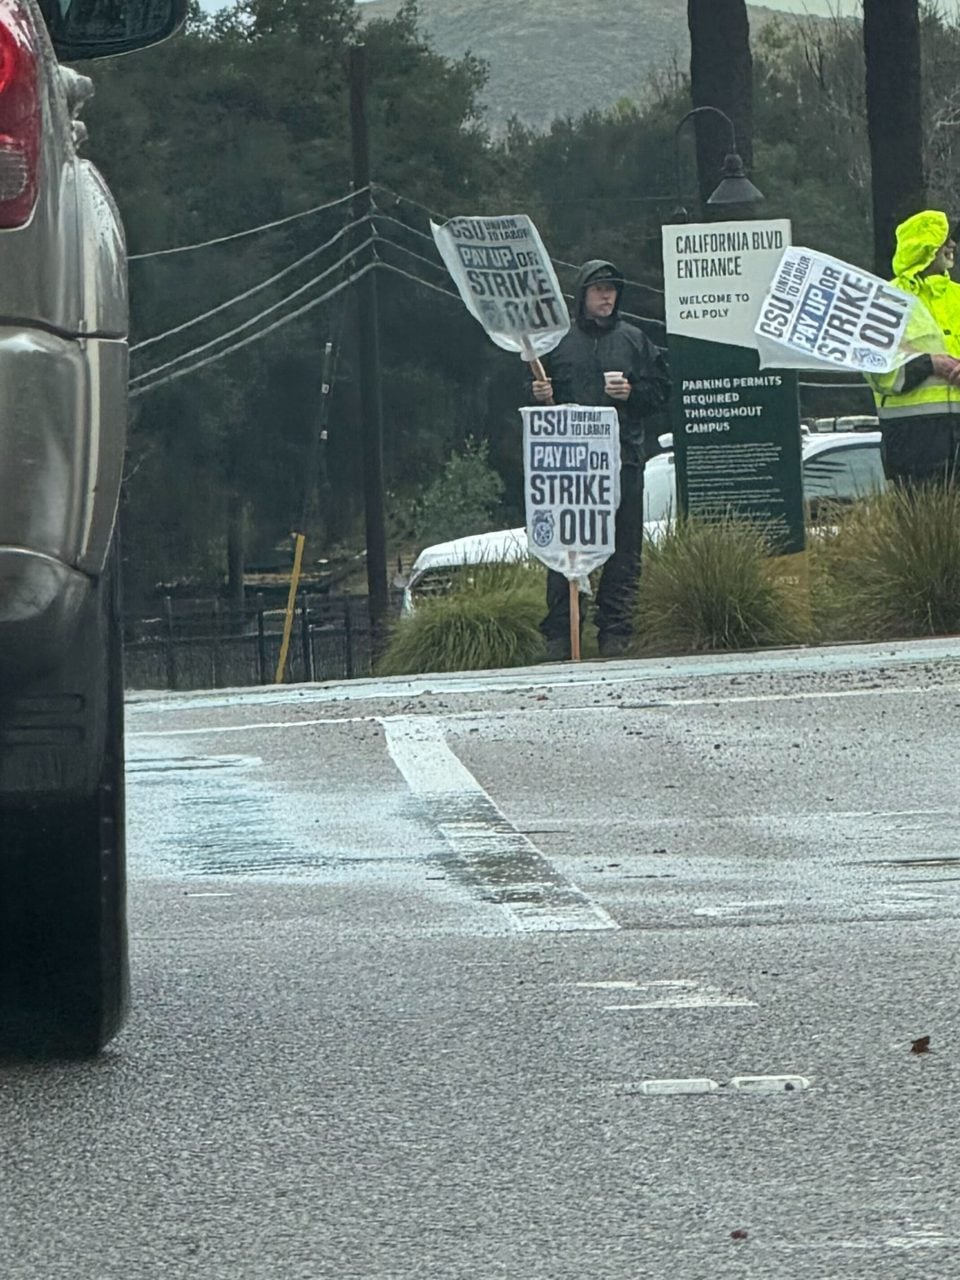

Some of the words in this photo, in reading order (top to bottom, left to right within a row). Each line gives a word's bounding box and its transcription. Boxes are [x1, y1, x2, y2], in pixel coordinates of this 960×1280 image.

[448, 219, 486, 241] CSU
[488, 231, 499, 241] TO
[676, 231, 750, 255] CALIFORNIA
[752, 230, 783, 250] BLVD
[460, 247, 489, 267] PAY
[489, 248, 513, 268] UP
[516, 251, 540, 268] OR
[677, 256, 742, 279] ENTRANCE
[775, 260, 796, 294] UNFAIR
[793, 255, 811, 286] LABOR
[819, 266, 842, 291] OR
[466, 269, 552, 300] STRIKE
[787, 284, 800, 298] TO
[679, 293, 732, 305] WELCOME
[735, 293, 750, 303] TO
[804, 288, 828, 317] UP
[679, 311, 699, 320] CAL
[702, 308, 729, 319] POLY
[759, 293, 794, 338] CSU
[817, 273, 873, 363] STRIKE
[859, 285, 908, 350] OUT
[793, 313, 820, 349] PAY
[682, 378, 731, 390] PARKING
[733, 376, 782, 388] PERMITS
[683, 393, 740, 405] REQUIRED
[530, 410, 568, 436] CSU
[685, 406, 763, 418] THROUGHOUT
[571, 424, 582, 436] TO
[583, 424, 610, 436] LABOR
[685, 422, 730, 433] CAMPUS
[534, 445, 562, 468] PAY
[566, 445, 586, 468] UP
[590, 451, 609, 470] OR
[531, 474, 610, 505] STRIKE
[560, 509, 610, 546] OUT
